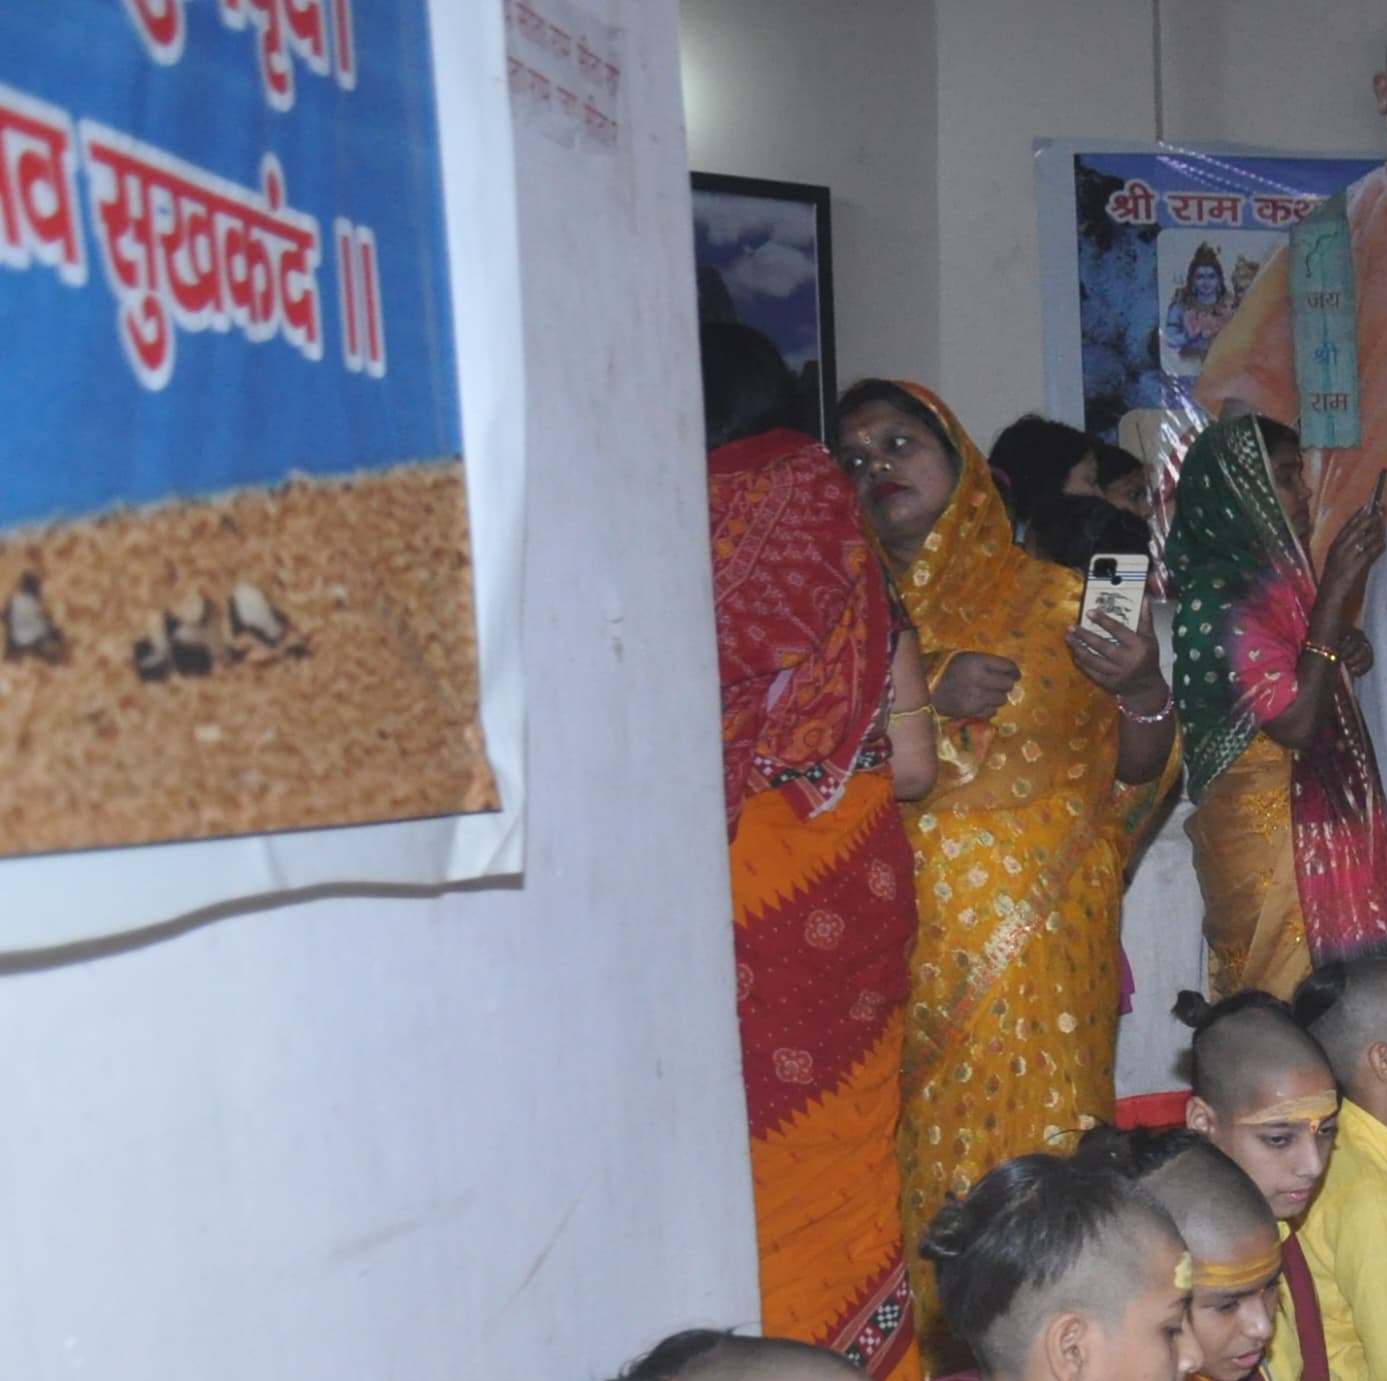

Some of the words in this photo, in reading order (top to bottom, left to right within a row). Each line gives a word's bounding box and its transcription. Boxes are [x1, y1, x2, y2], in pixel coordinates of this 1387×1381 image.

[1110, 181, 1155, 222] श्री
[1167, 193, 1243, 224] राम
[88, 138, 316, 373] सुखकंद
[1306, 291, 1342, 310] जय
[1313, 341, 1339, 366] श्री
[1310, 392, 1349, 413] राम
